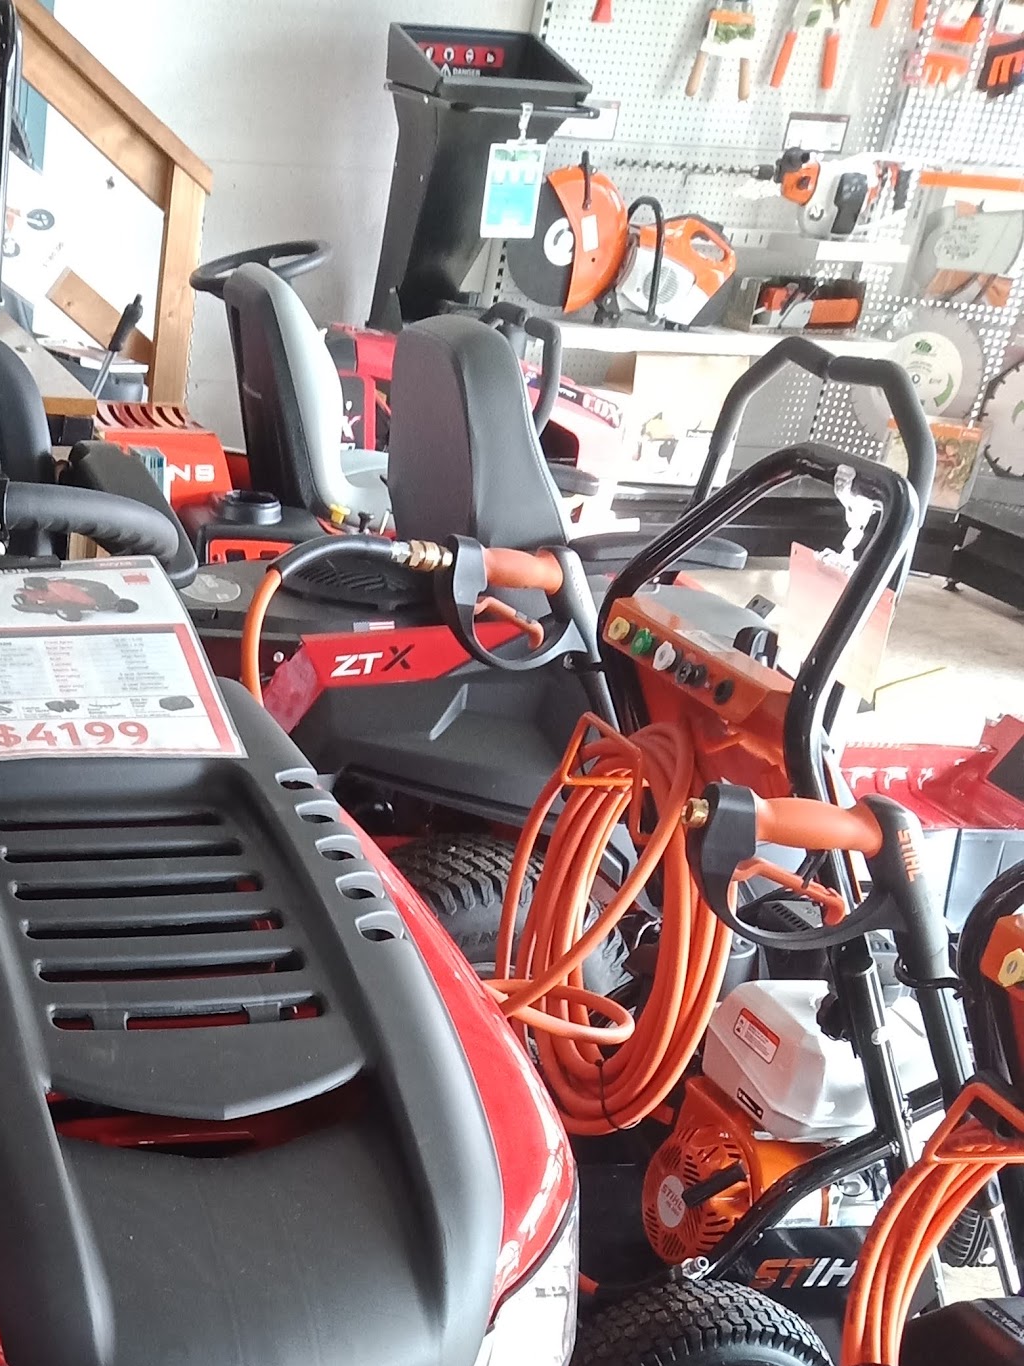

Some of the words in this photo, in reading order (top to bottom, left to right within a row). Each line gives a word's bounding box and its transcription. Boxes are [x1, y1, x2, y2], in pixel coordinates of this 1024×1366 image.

[897, 828, 922, 883] STIHL
[661, 1183, 684, 1211] STIHL
[748, 1257, 859, 1289] STIH
